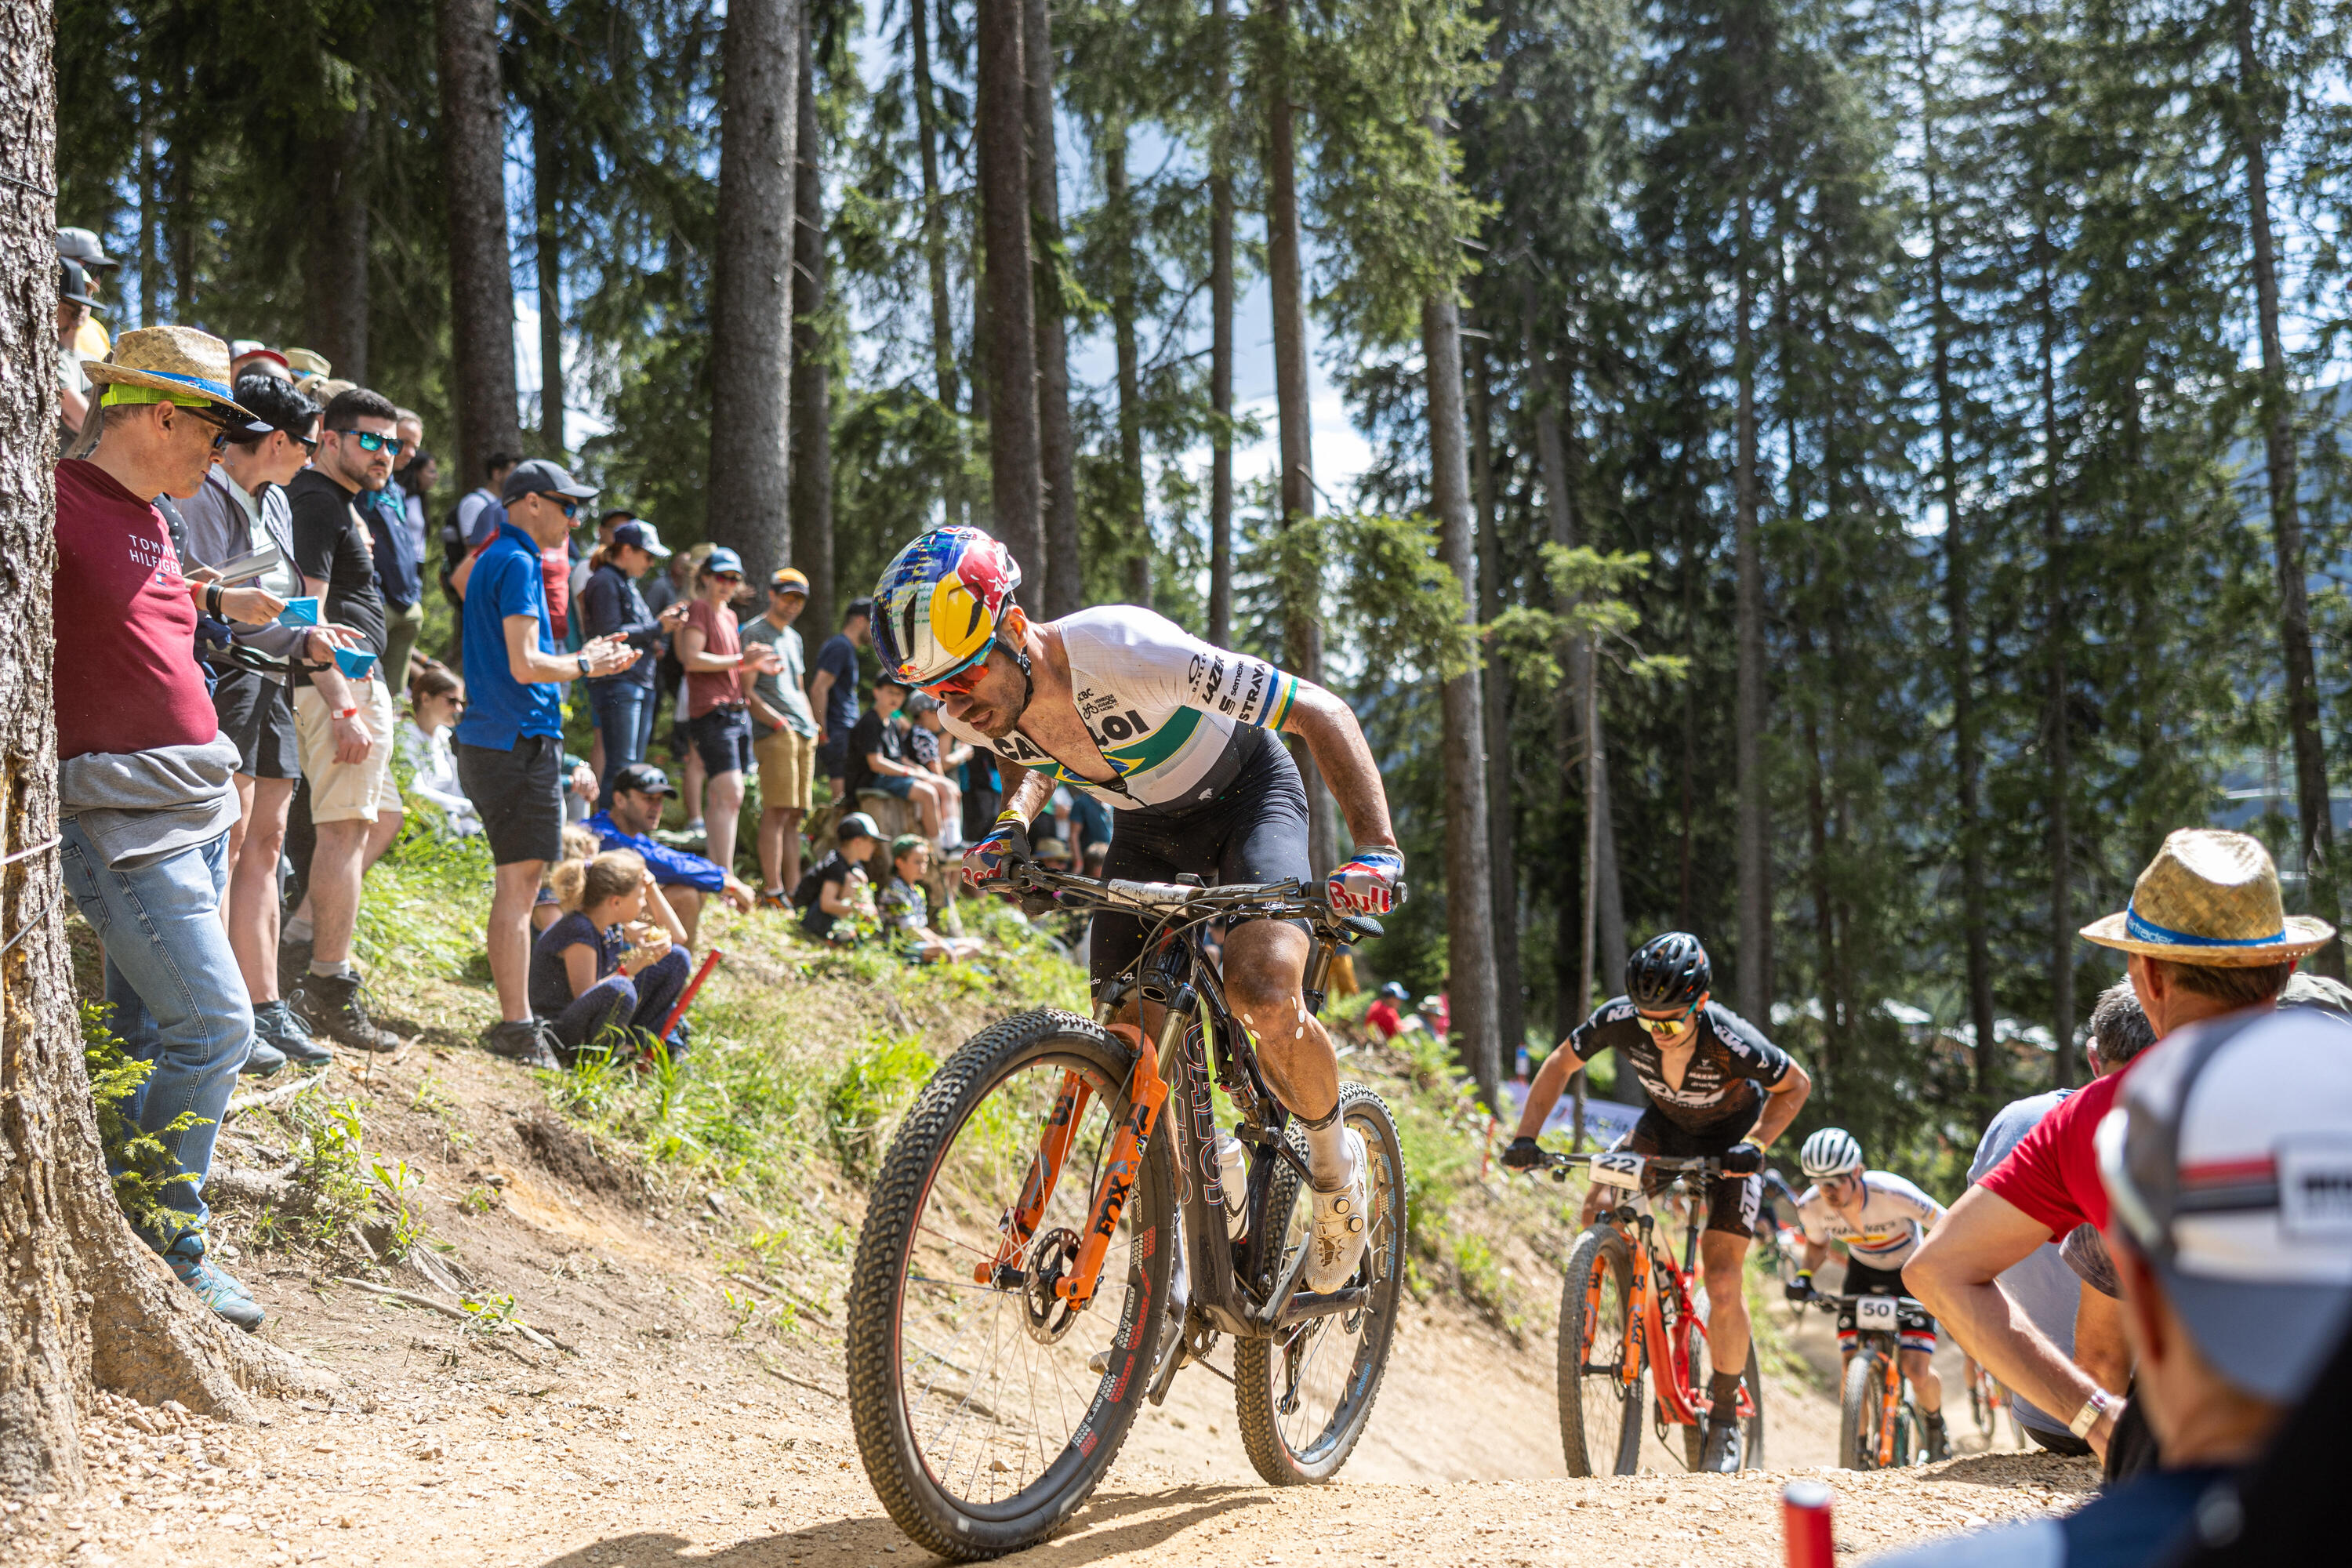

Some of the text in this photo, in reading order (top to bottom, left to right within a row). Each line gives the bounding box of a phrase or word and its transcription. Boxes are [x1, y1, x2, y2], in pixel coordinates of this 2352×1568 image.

[1201, 655, 1225, 705] LAZER
[1230, 660, 1244, 697] semexe
[1238, 663, 1265, 722] STRAVA
[1328, 880, 1392, 914] Bull
[1713, 1024, 1751, 1058] KTM
[1598, 1156, 1637, 1176] 22
[1093, 1174, 1131, 1241] FOX
[1862, 1301, 1890, 1318] 50
[1632, 1312, 1644, 1344] FOX
